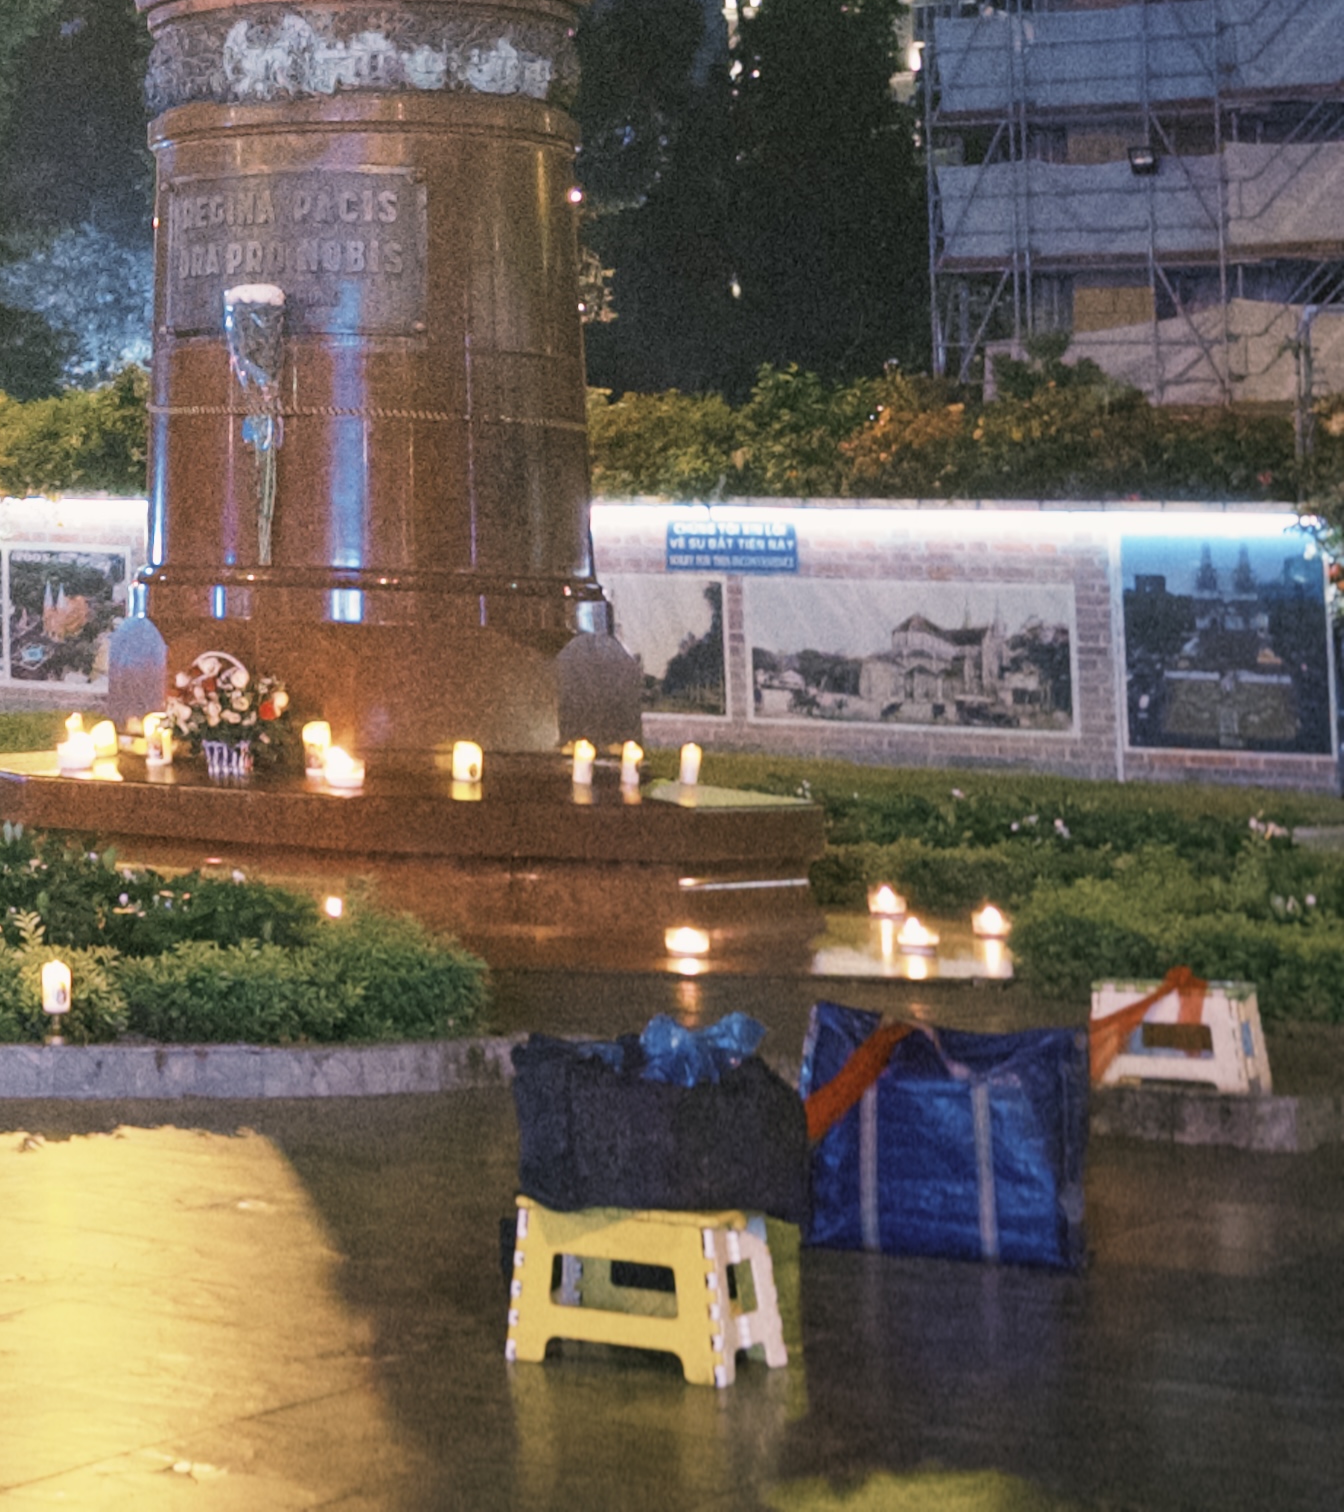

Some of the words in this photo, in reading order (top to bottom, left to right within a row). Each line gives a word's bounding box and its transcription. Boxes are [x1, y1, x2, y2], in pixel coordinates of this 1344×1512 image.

[181, 189, 276, 230] REGINA
[293, 187, 398, 224] PACIS
[178, 242, 220, 280] ORA
[225, 239, 286, 276] PRO
[296, 238, 404, 274] NOBIS
